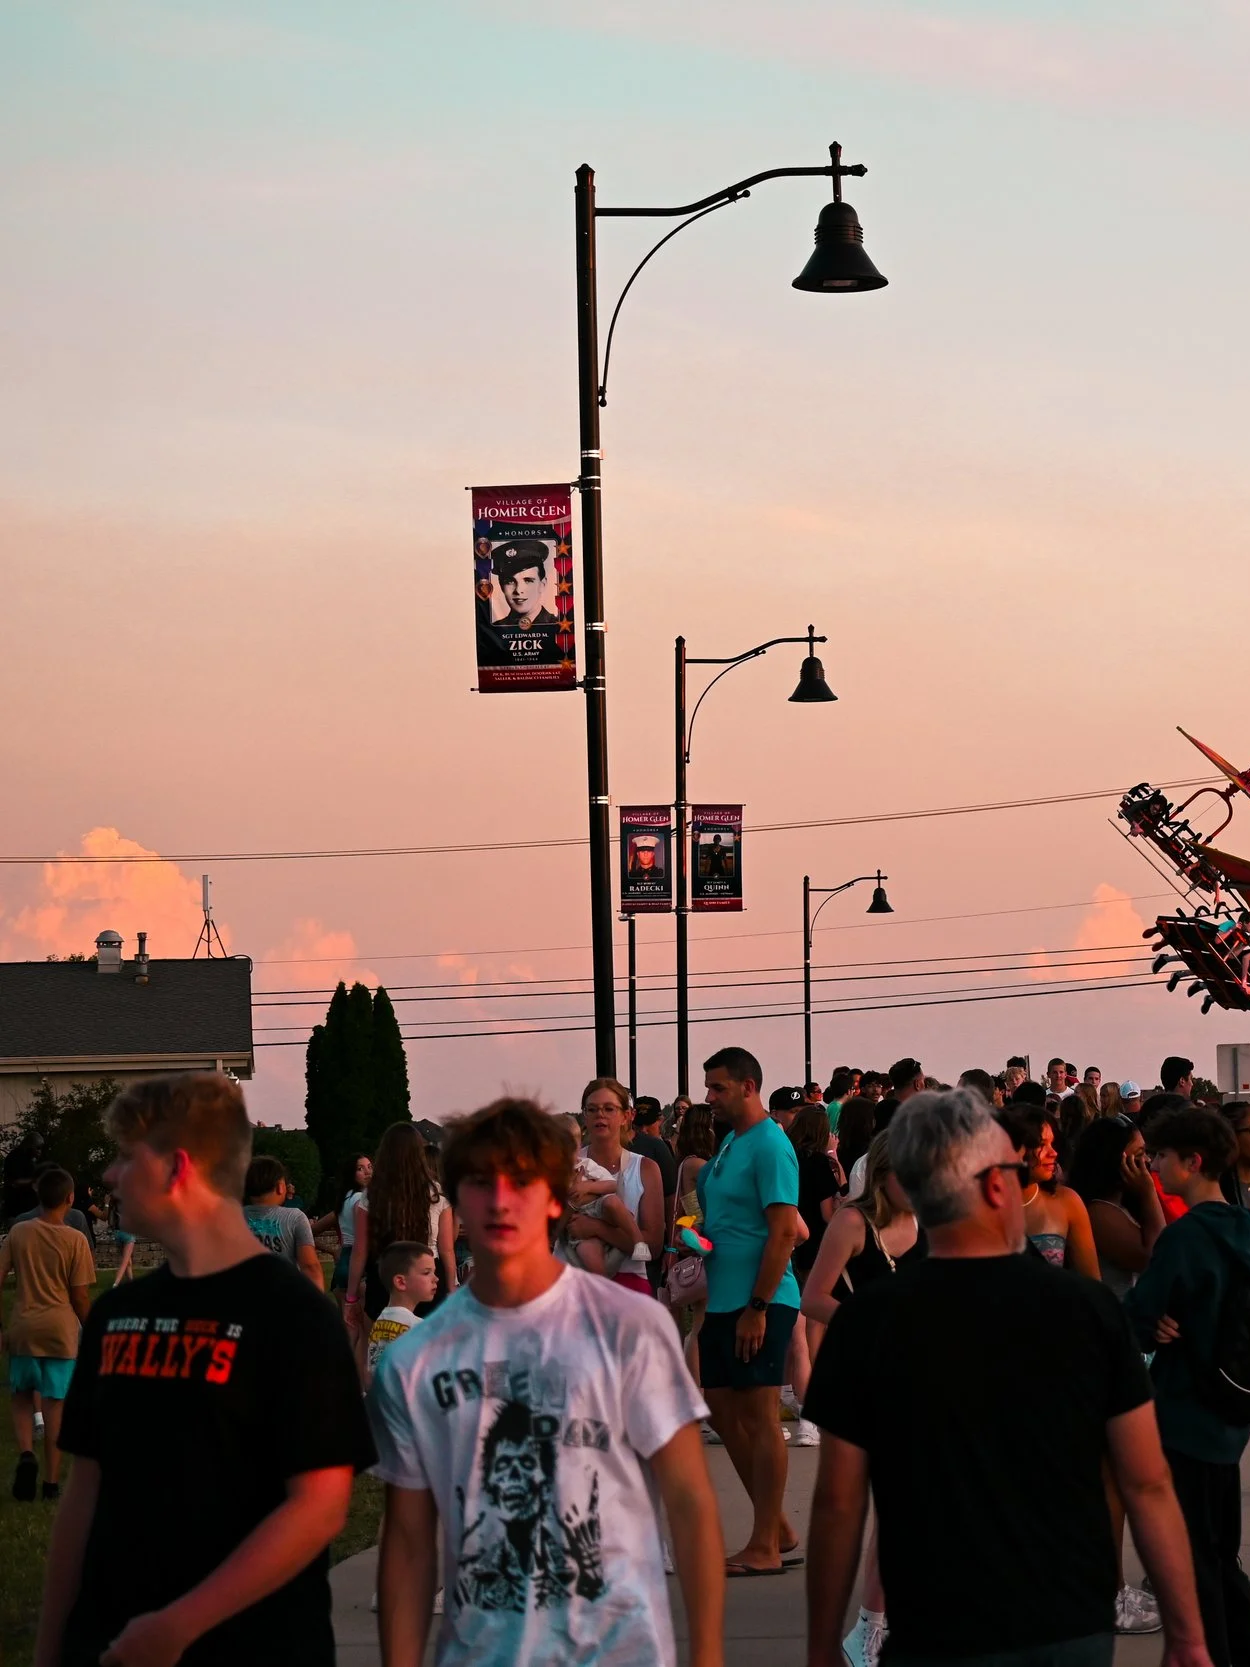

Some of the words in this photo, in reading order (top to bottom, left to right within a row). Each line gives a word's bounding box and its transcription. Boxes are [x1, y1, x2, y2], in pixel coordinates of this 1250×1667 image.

[478, 506, 528, 520] HOMER
[530, 505, 566, 519] GLEN
[508, 639, 544, 651] ZICK
[622, 815, 649, 823] HOMER
[649, 815, 669, 823] GLEN
[694, 814, 720, 822] HOMER
[720, 814, 740, 822] GLEN
[703, 884, 730, 892] QUINN
[107, 1317, 149, 1333] WHERE
[154, 1318, 180, 1333] THE
[226, 1323, 243, 1338] IS
[98, 1332, 238, 1384] WALLY'S
[431, 1359, 567, 1413] GREEN
[532, 1414, 611, 1452] DAY
